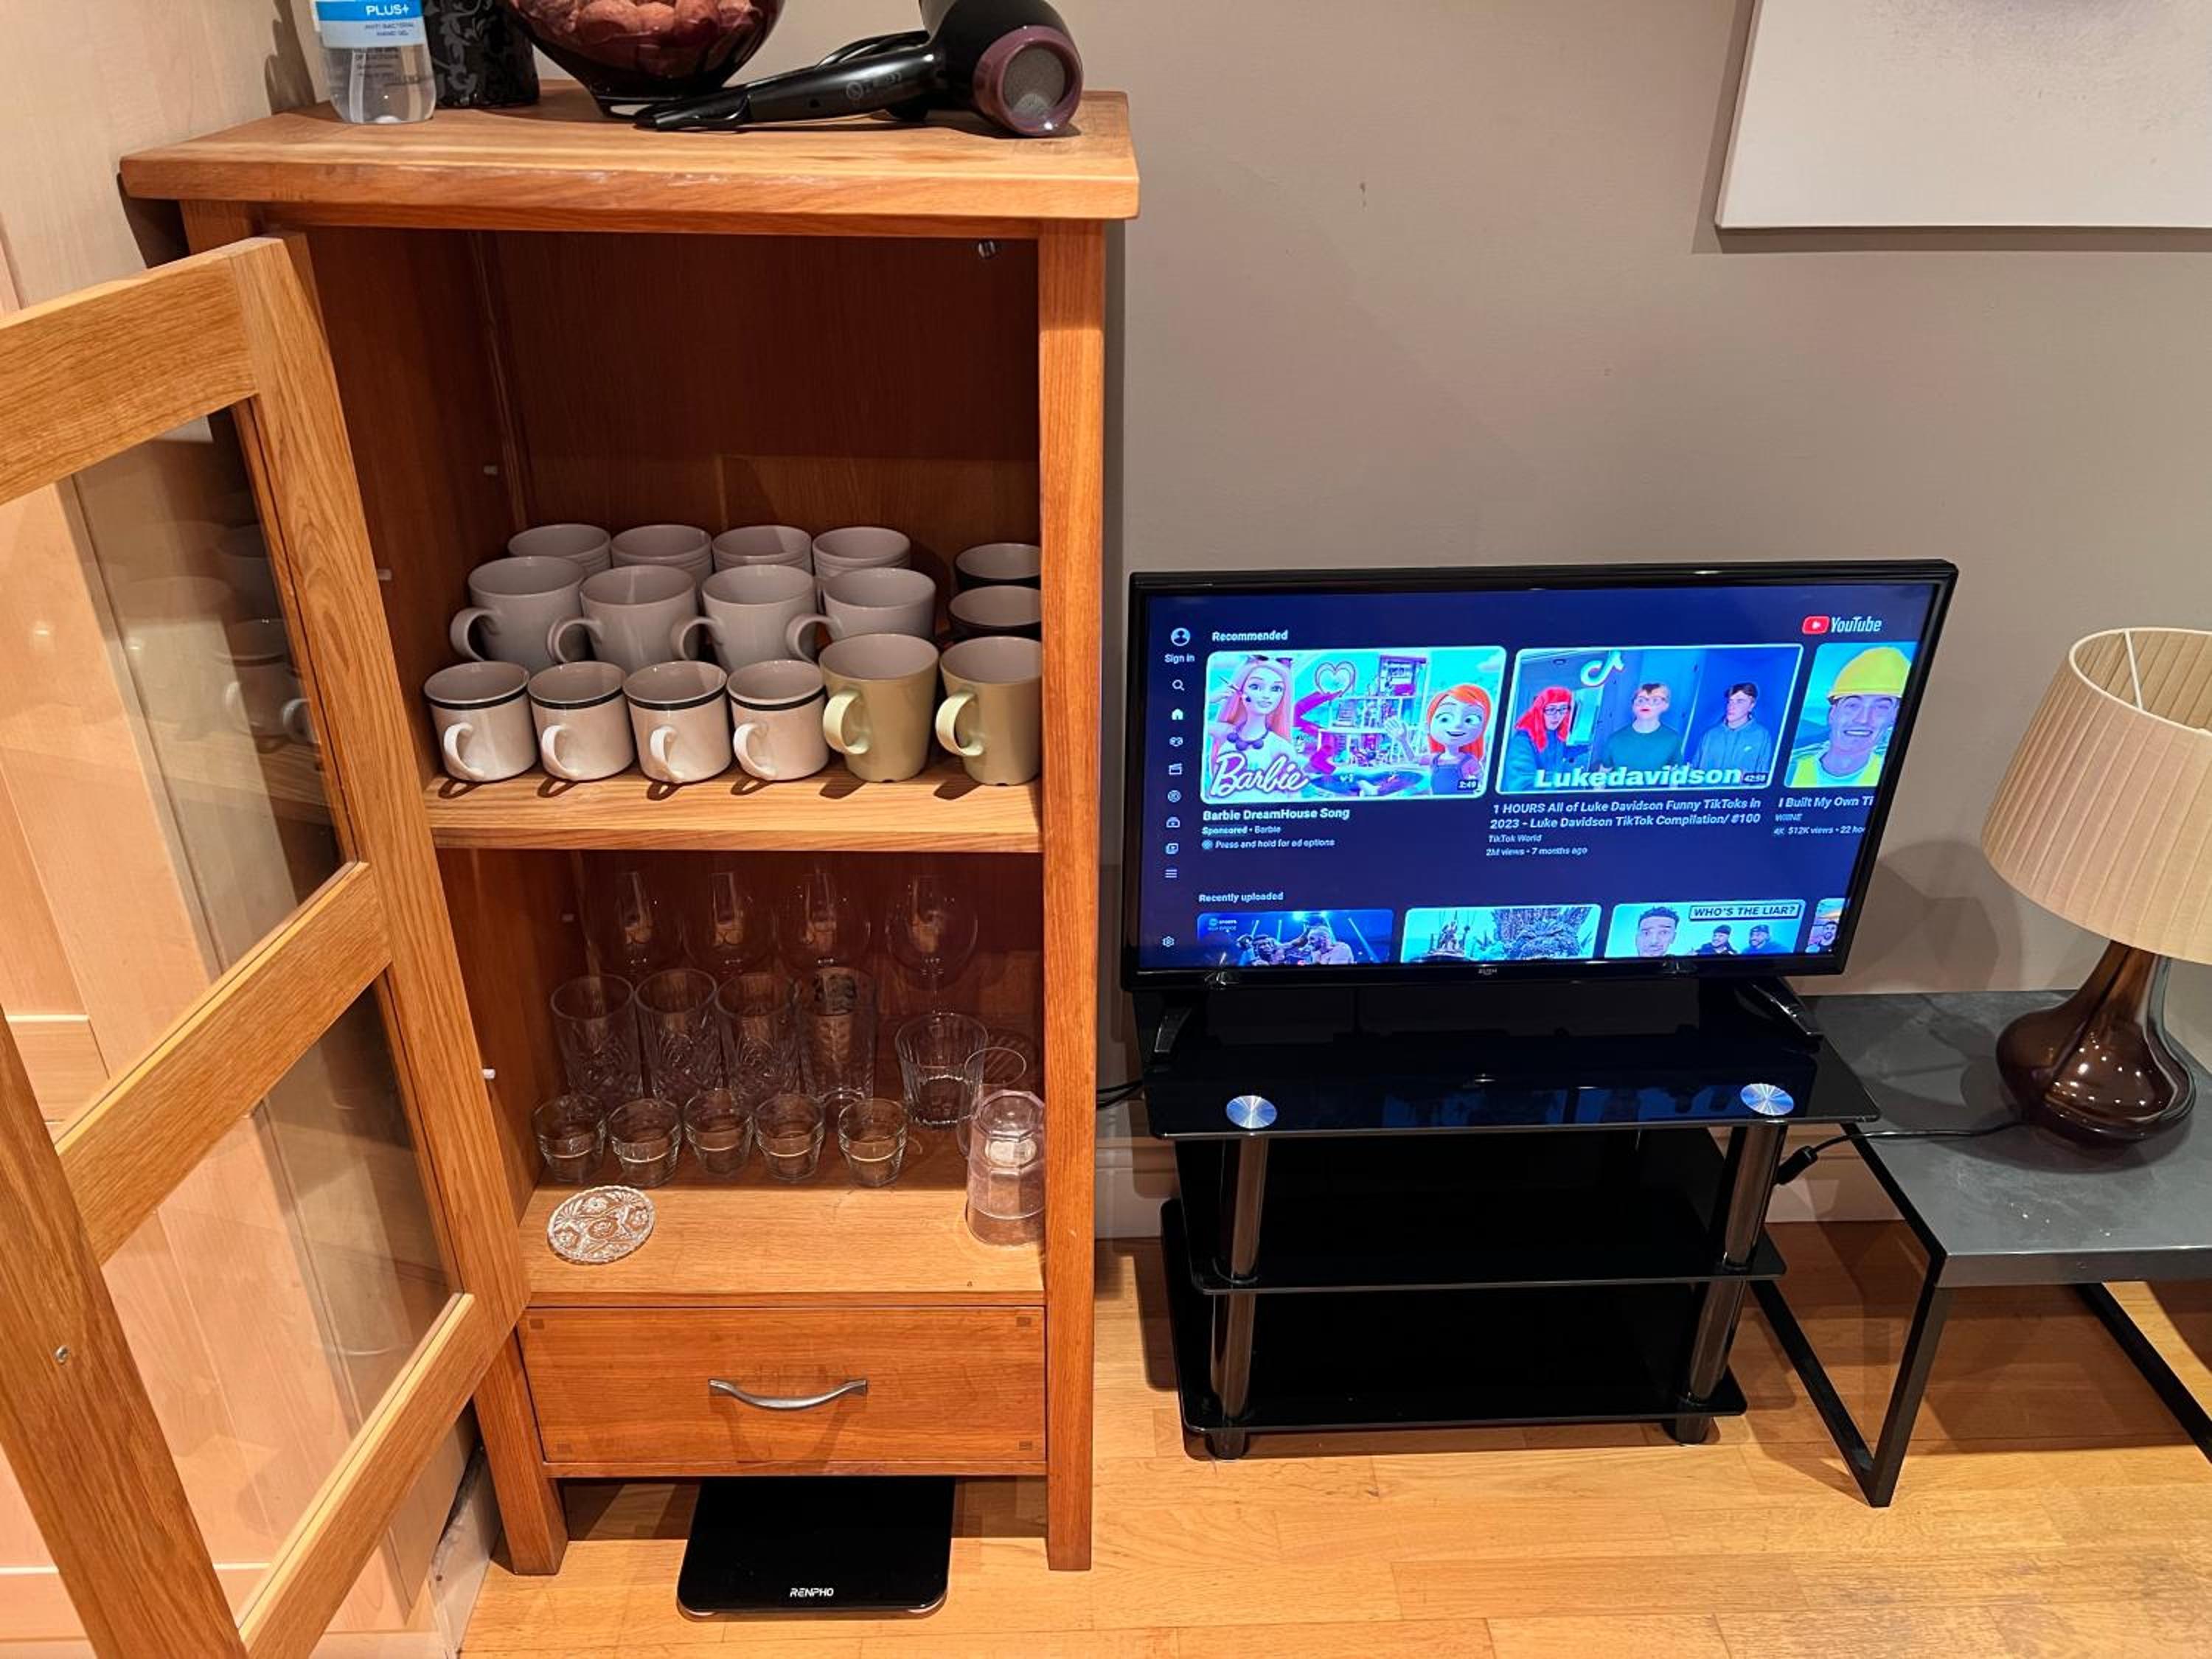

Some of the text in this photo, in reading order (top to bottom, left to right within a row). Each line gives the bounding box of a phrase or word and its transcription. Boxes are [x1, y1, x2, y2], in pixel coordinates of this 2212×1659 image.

[366, 4, 408, 15] PLUS+
[1831, 616, 1882, 633] YouTube
[1211, 630, 1288, 641] Recommended
[1164, 654, 1195, 664] Sign in
[1210, 751, 1310, 797] Barbie
[1534, 765, 1741, 788] Lukedavidson
[1493, 798, 1761, 814] 1 HOURS All of Luke Davidson Funny TikToks in
[1778, 797, 1784, 807] I
[1785, 797, 1812, 807] Built
[1813, 797, 1832, 809] My
[1834, 796, 1859, 807] Own
[1203, 808, 1350, 821] Barbie DreamHouse Song
[1490, 818, 1520, 830] 2023
[1530, 818, 1558, 828] Luke
[1560, 816, 1613, 827] Davidson
[1615, 815, 1653, 826] TikTok
[1656, 814, 1730, 827] Compilation/
[1202, 826, 1248, 835] Sponsored
[1840, 826, 1851, 834] 22
[1240, 840, 1256, 848] and
[1258, 839, 1276, 847] hold
[1278, 838, 1290, 846] for
[1303, 839, 1335, 848] options
[1489, 834, 1542, 843] TikTok World
[1502, 848, 1525, 856] views
[1539, 847, 1571, 855] months
[1572, 847, 1587, 855] ago
[1198, 891, 1284, 902] Recently uploaded
[1694, 906, 1795, 917] WHO'S THE LIAR?
[790, 1587, 834, 1598] RENPHO
